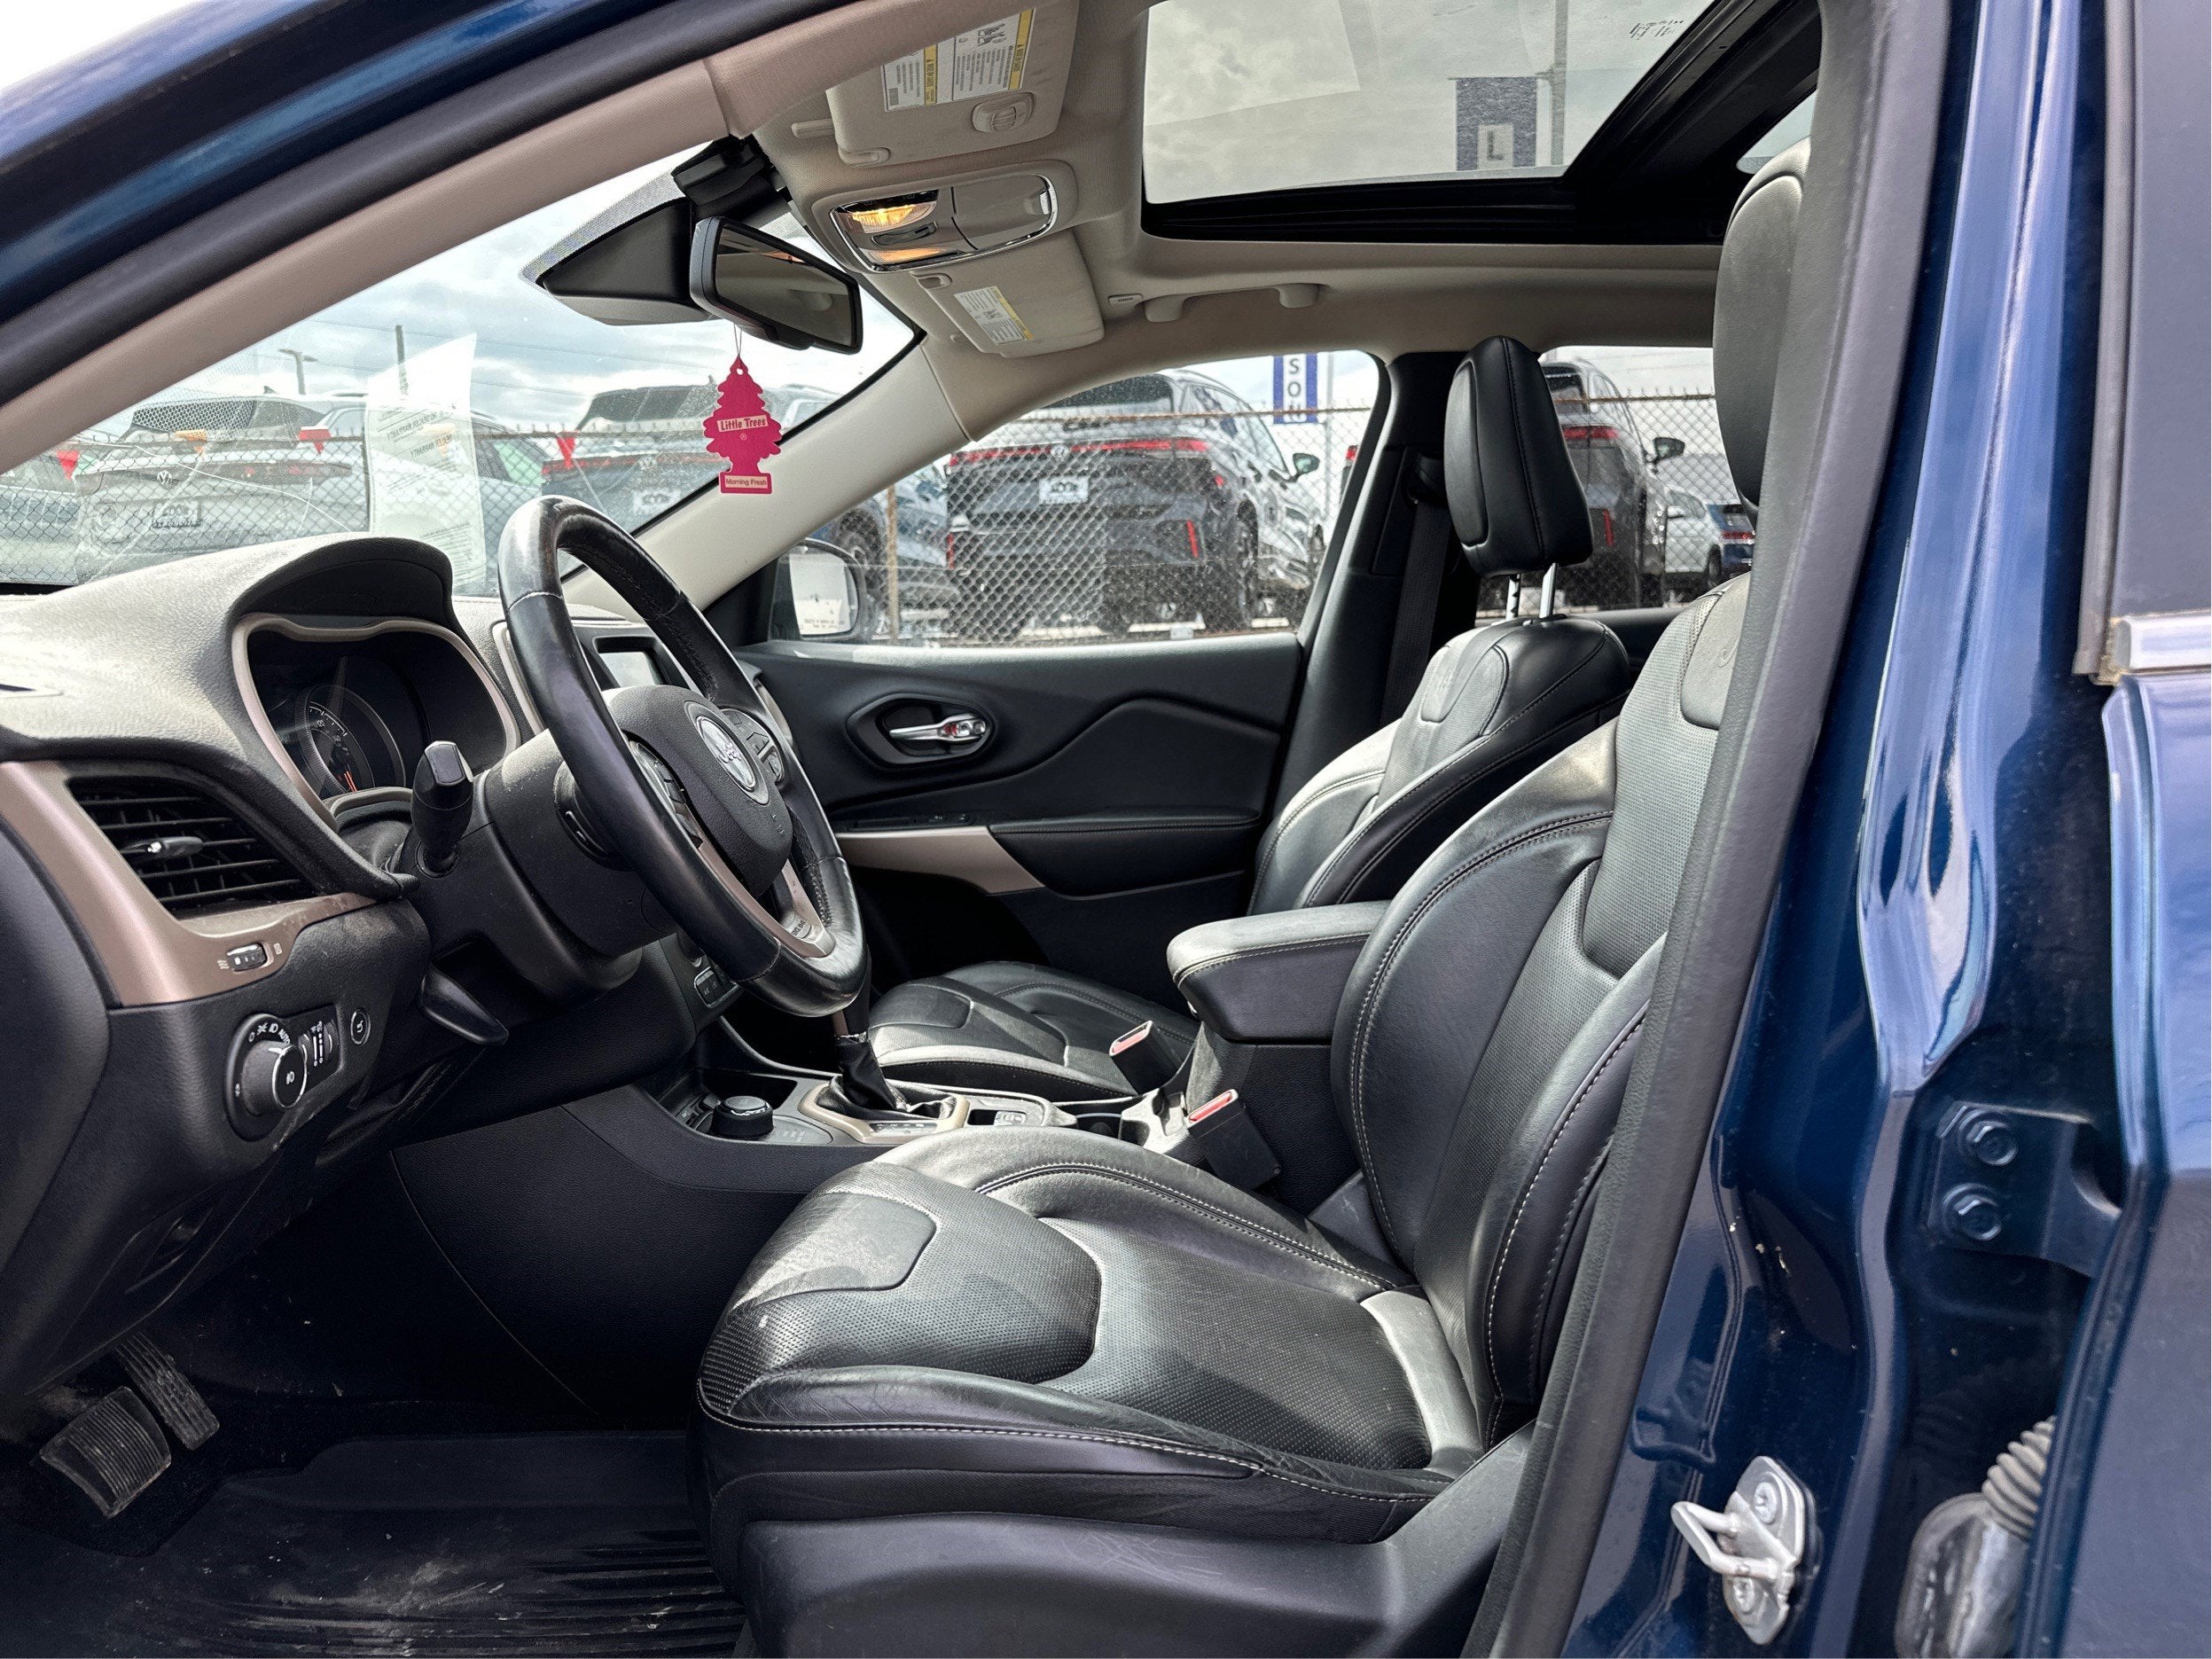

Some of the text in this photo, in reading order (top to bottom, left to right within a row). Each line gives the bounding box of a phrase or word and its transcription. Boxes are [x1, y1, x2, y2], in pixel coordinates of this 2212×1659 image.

[1487, 130, 1504, 161] L
[720, 417, 766, 431] Little Trees
[278, 1029, 291, 1045] AUTO
